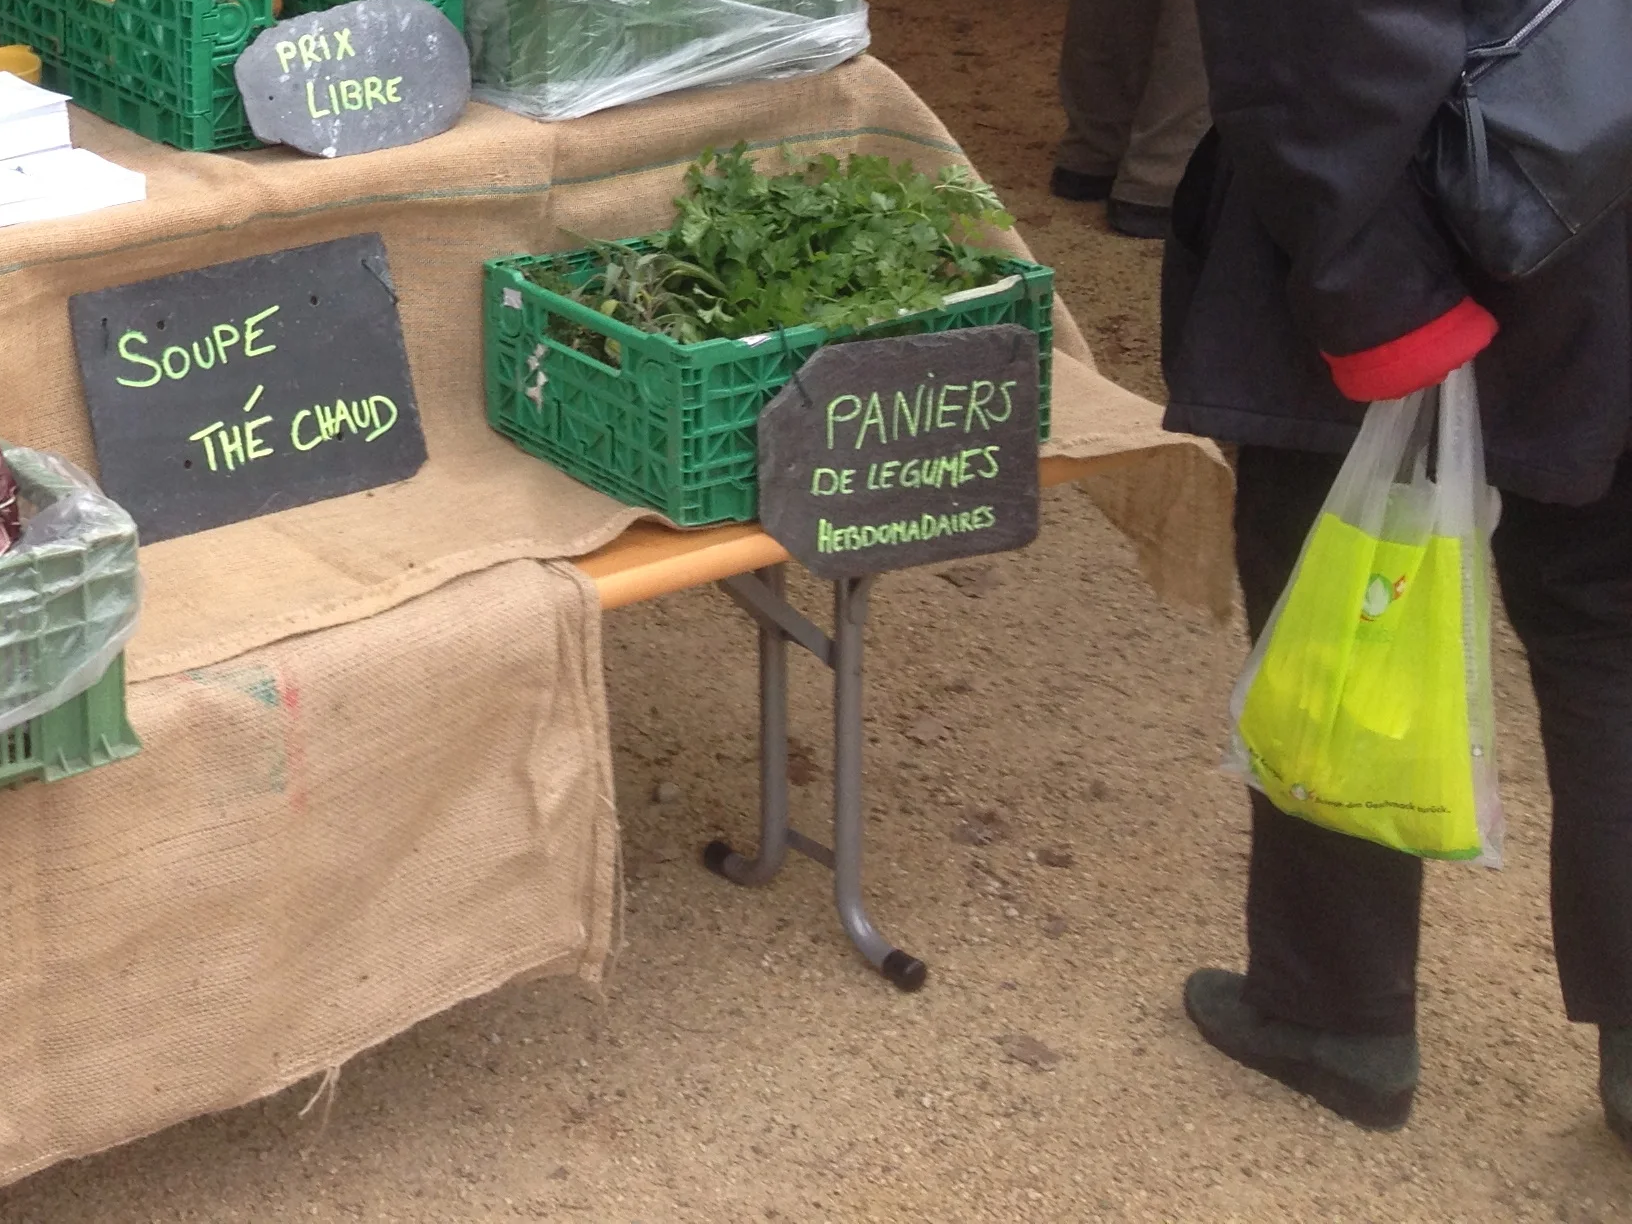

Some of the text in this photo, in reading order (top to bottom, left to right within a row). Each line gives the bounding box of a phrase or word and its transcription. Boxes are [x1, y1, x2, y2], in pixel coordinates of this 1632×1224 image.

[275, 28, 355, 73] PRIX
[306, 76, 403, 118] LIBRE
[116, 305, 280, 387] SOUPE
[189, 384, 398, 471] THÉ CHAUD
[827, 373, 1017, 449] PANIERS
[810, 445, 1000, 496] DE LEGUMES
[818, 506, 996, 554] HEBDOMADAIRES
